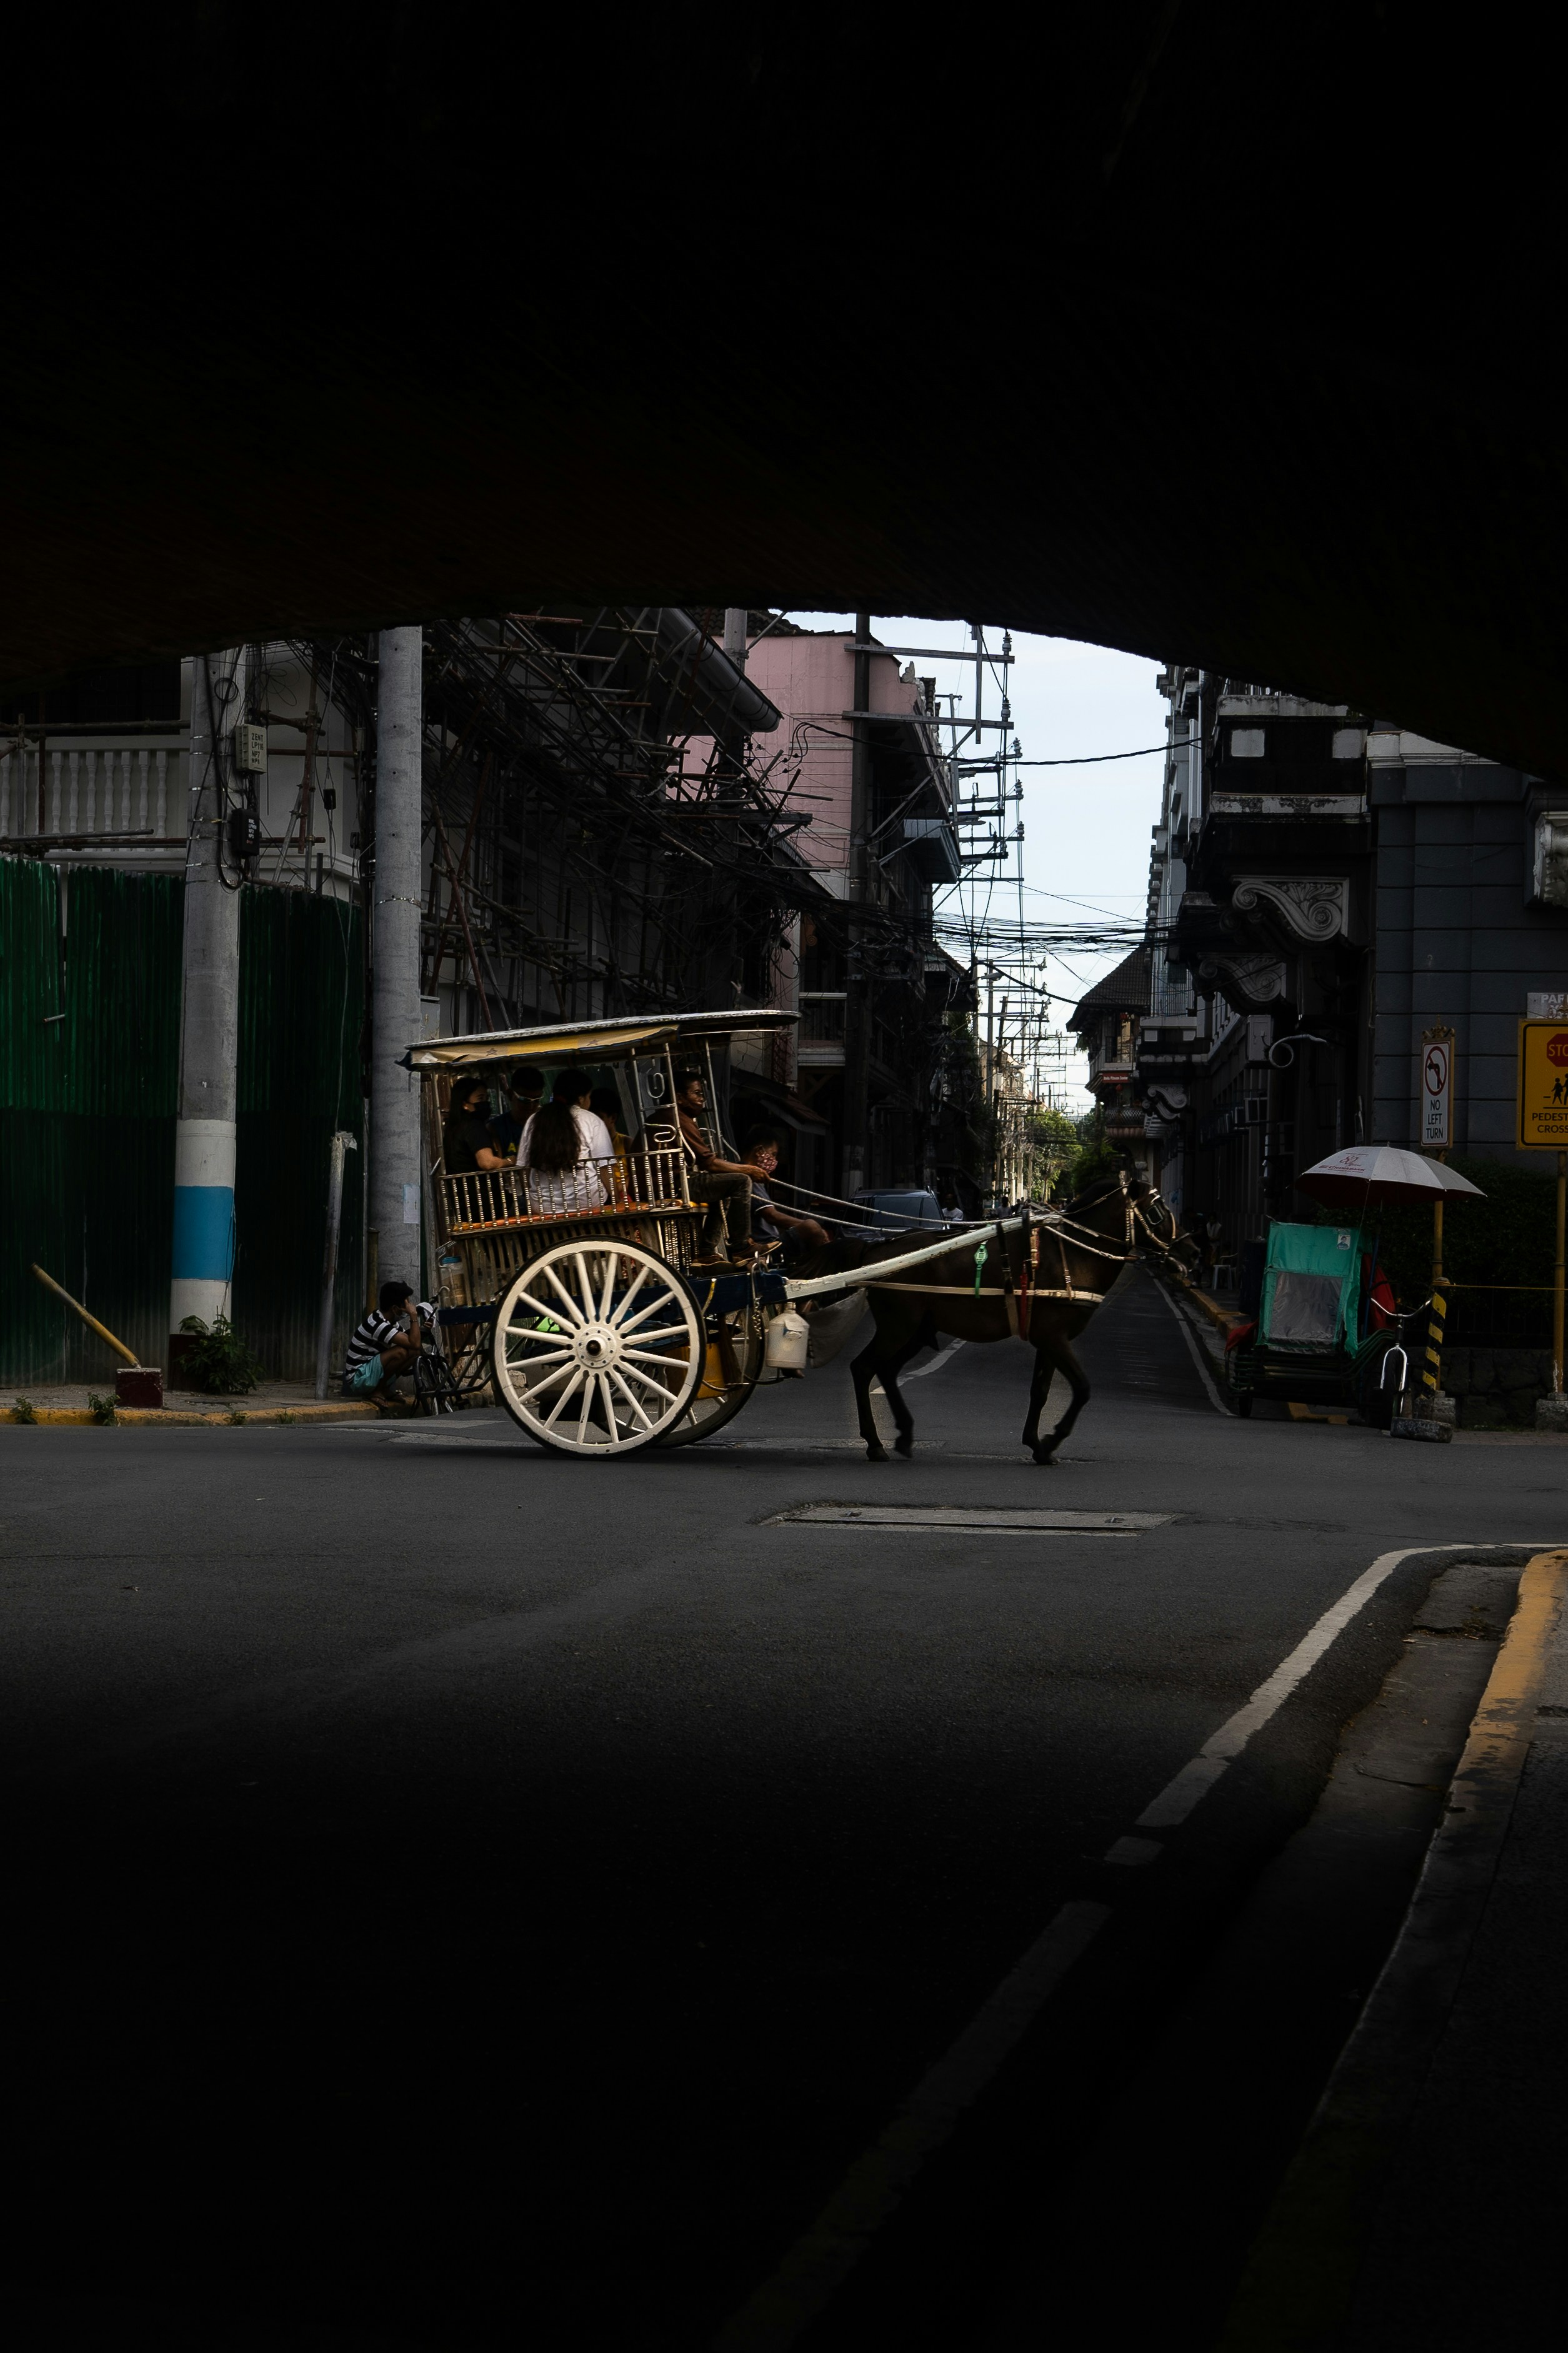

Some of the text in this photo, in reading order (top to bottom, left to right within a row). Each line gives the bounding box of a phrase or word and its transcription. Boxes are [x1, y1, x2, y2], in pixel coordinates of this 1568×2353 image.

[251, 733, 263, 742] ZENT
[1430, 1099, 1441, 1111] NO
[1427, 1113, 1442, 1125] LEFT
[1426, 1127, 1444, 1140] TURN
